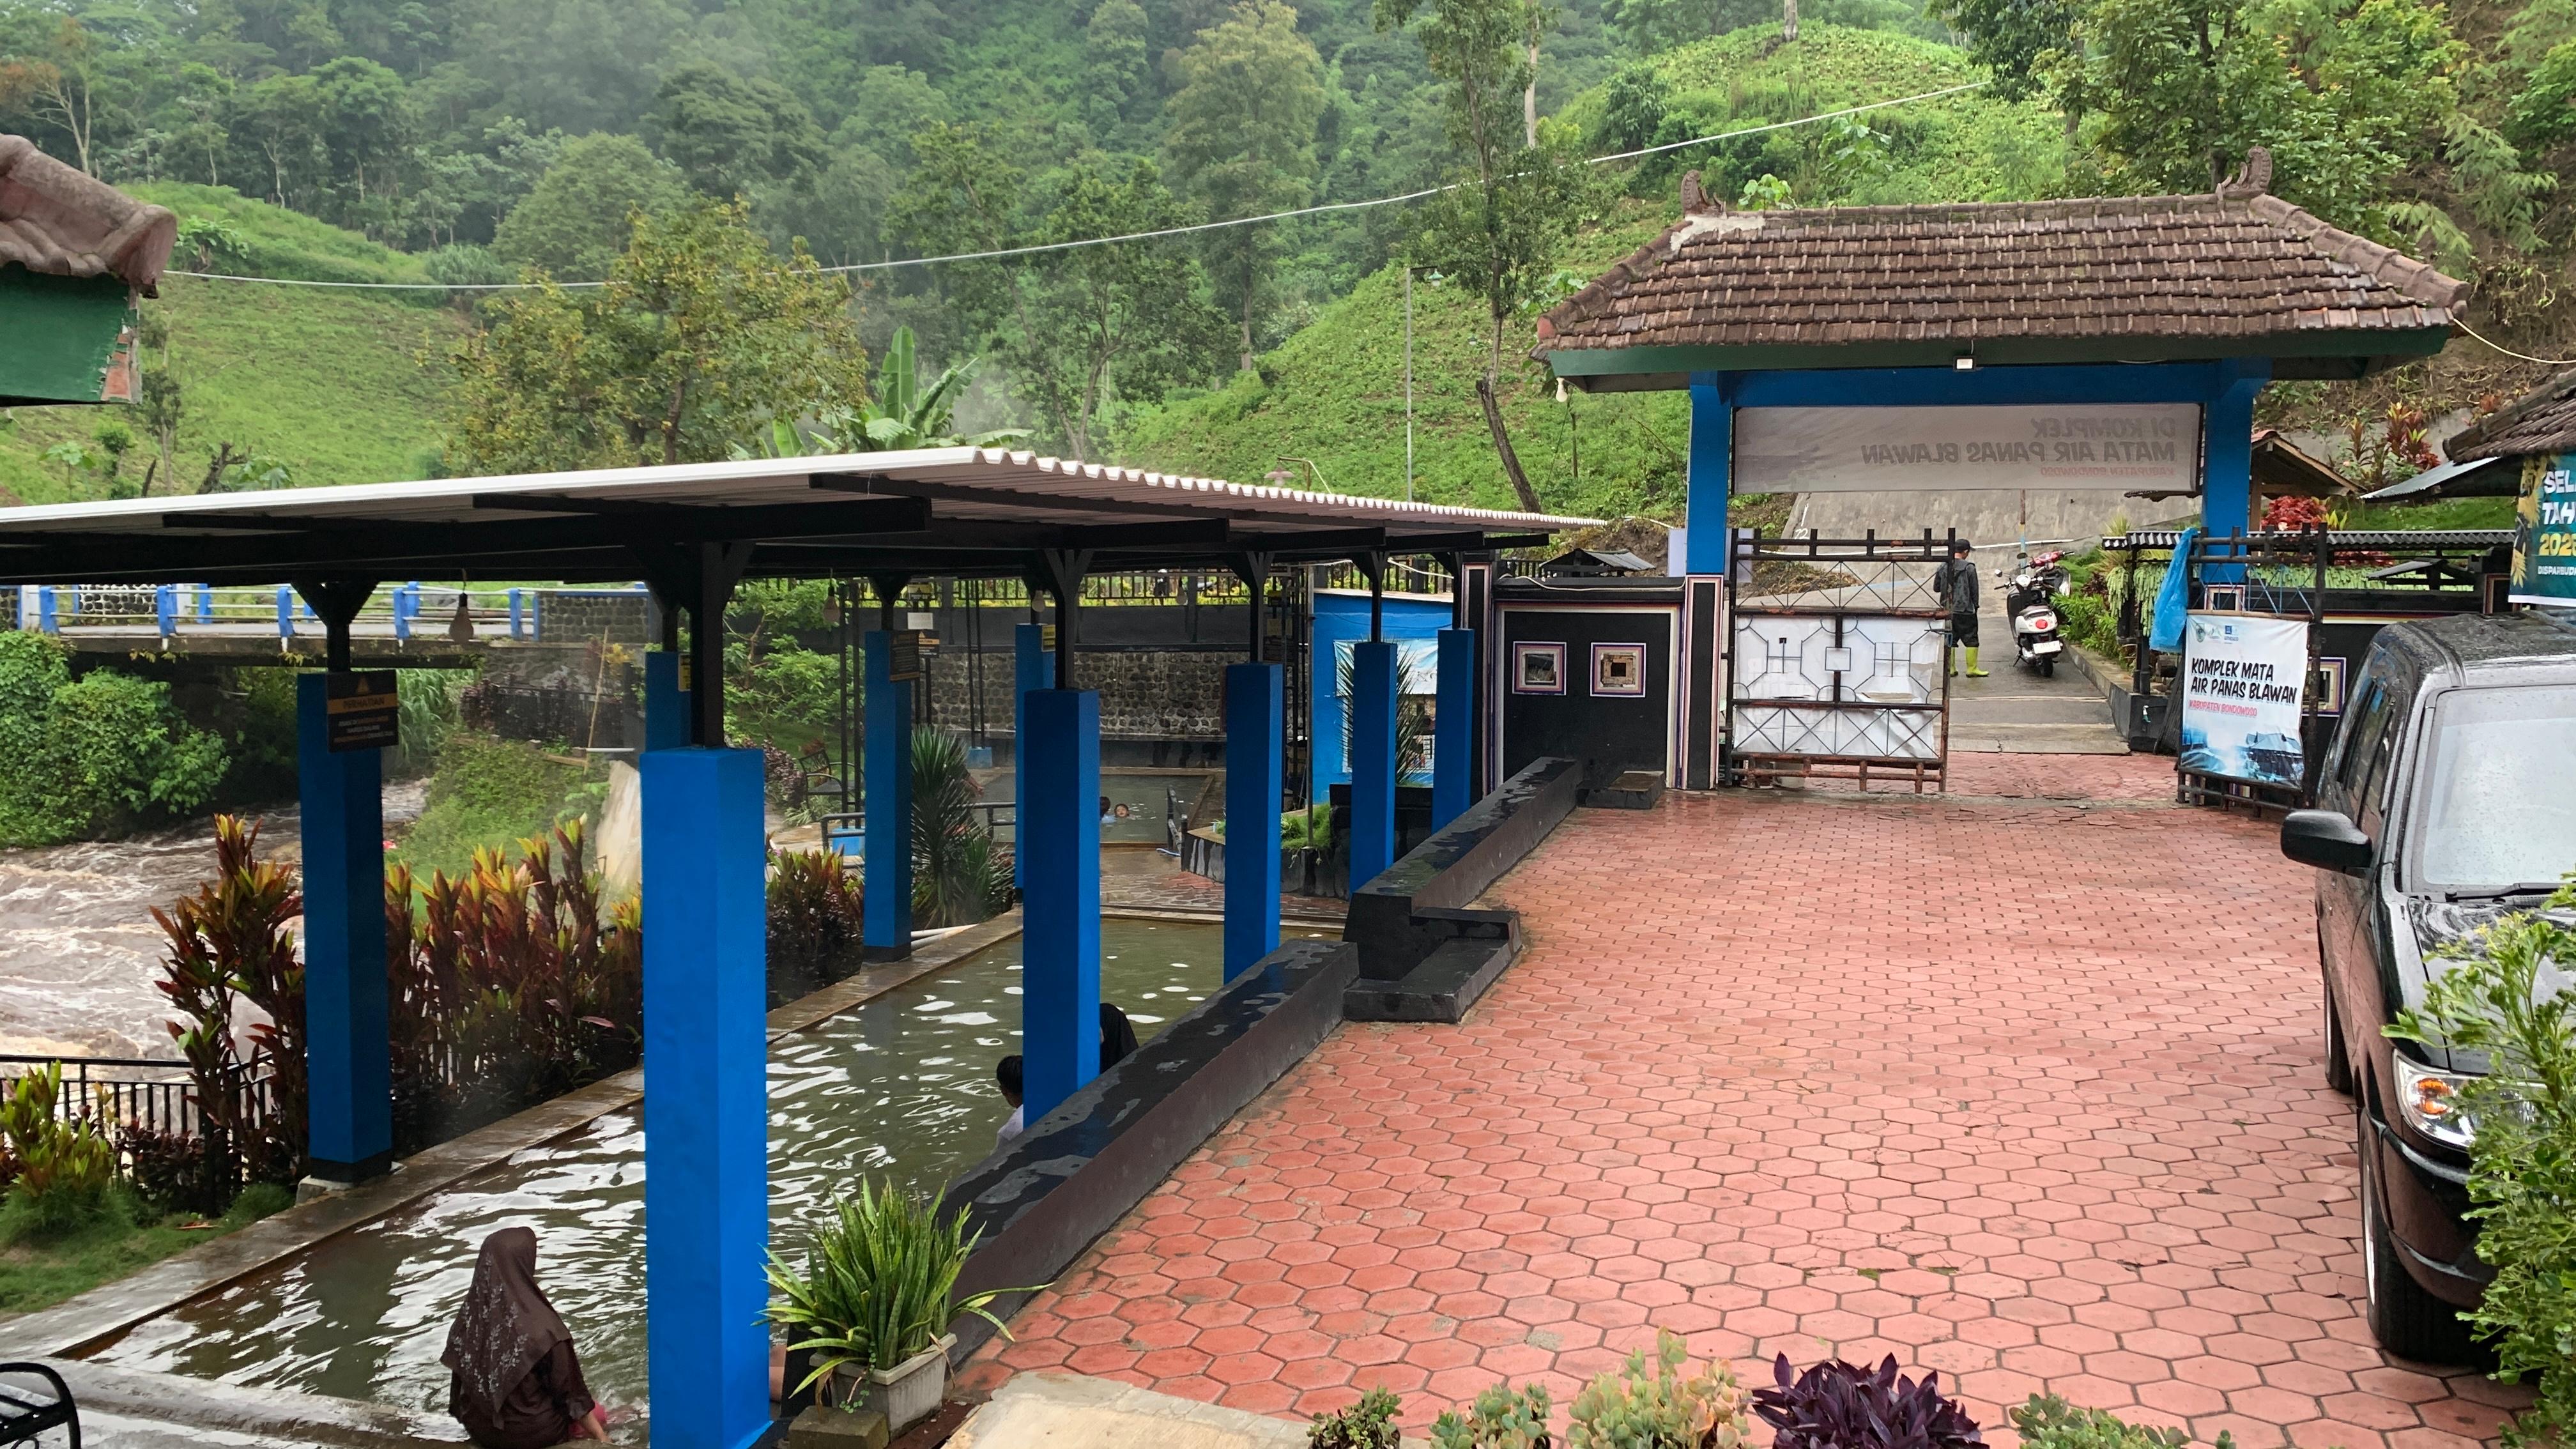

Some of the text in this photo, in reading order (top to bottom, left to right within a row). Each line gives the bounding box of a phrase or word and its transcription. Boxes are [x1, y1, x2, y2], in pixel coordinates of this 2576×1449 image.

[2544, 470, 2576, 494] SEL
[2542, 502, 2576, 525] TAH
[2538, 565, 2576, 576] DISPARBUD
[2191, 657, 2274, 682] KOMPLEK MATA
[2191, 677, 2297, 703] AIR PANAS BLAWAN
[2189, 700, 2258, 716] KABUPATEN BONDOWOSO
